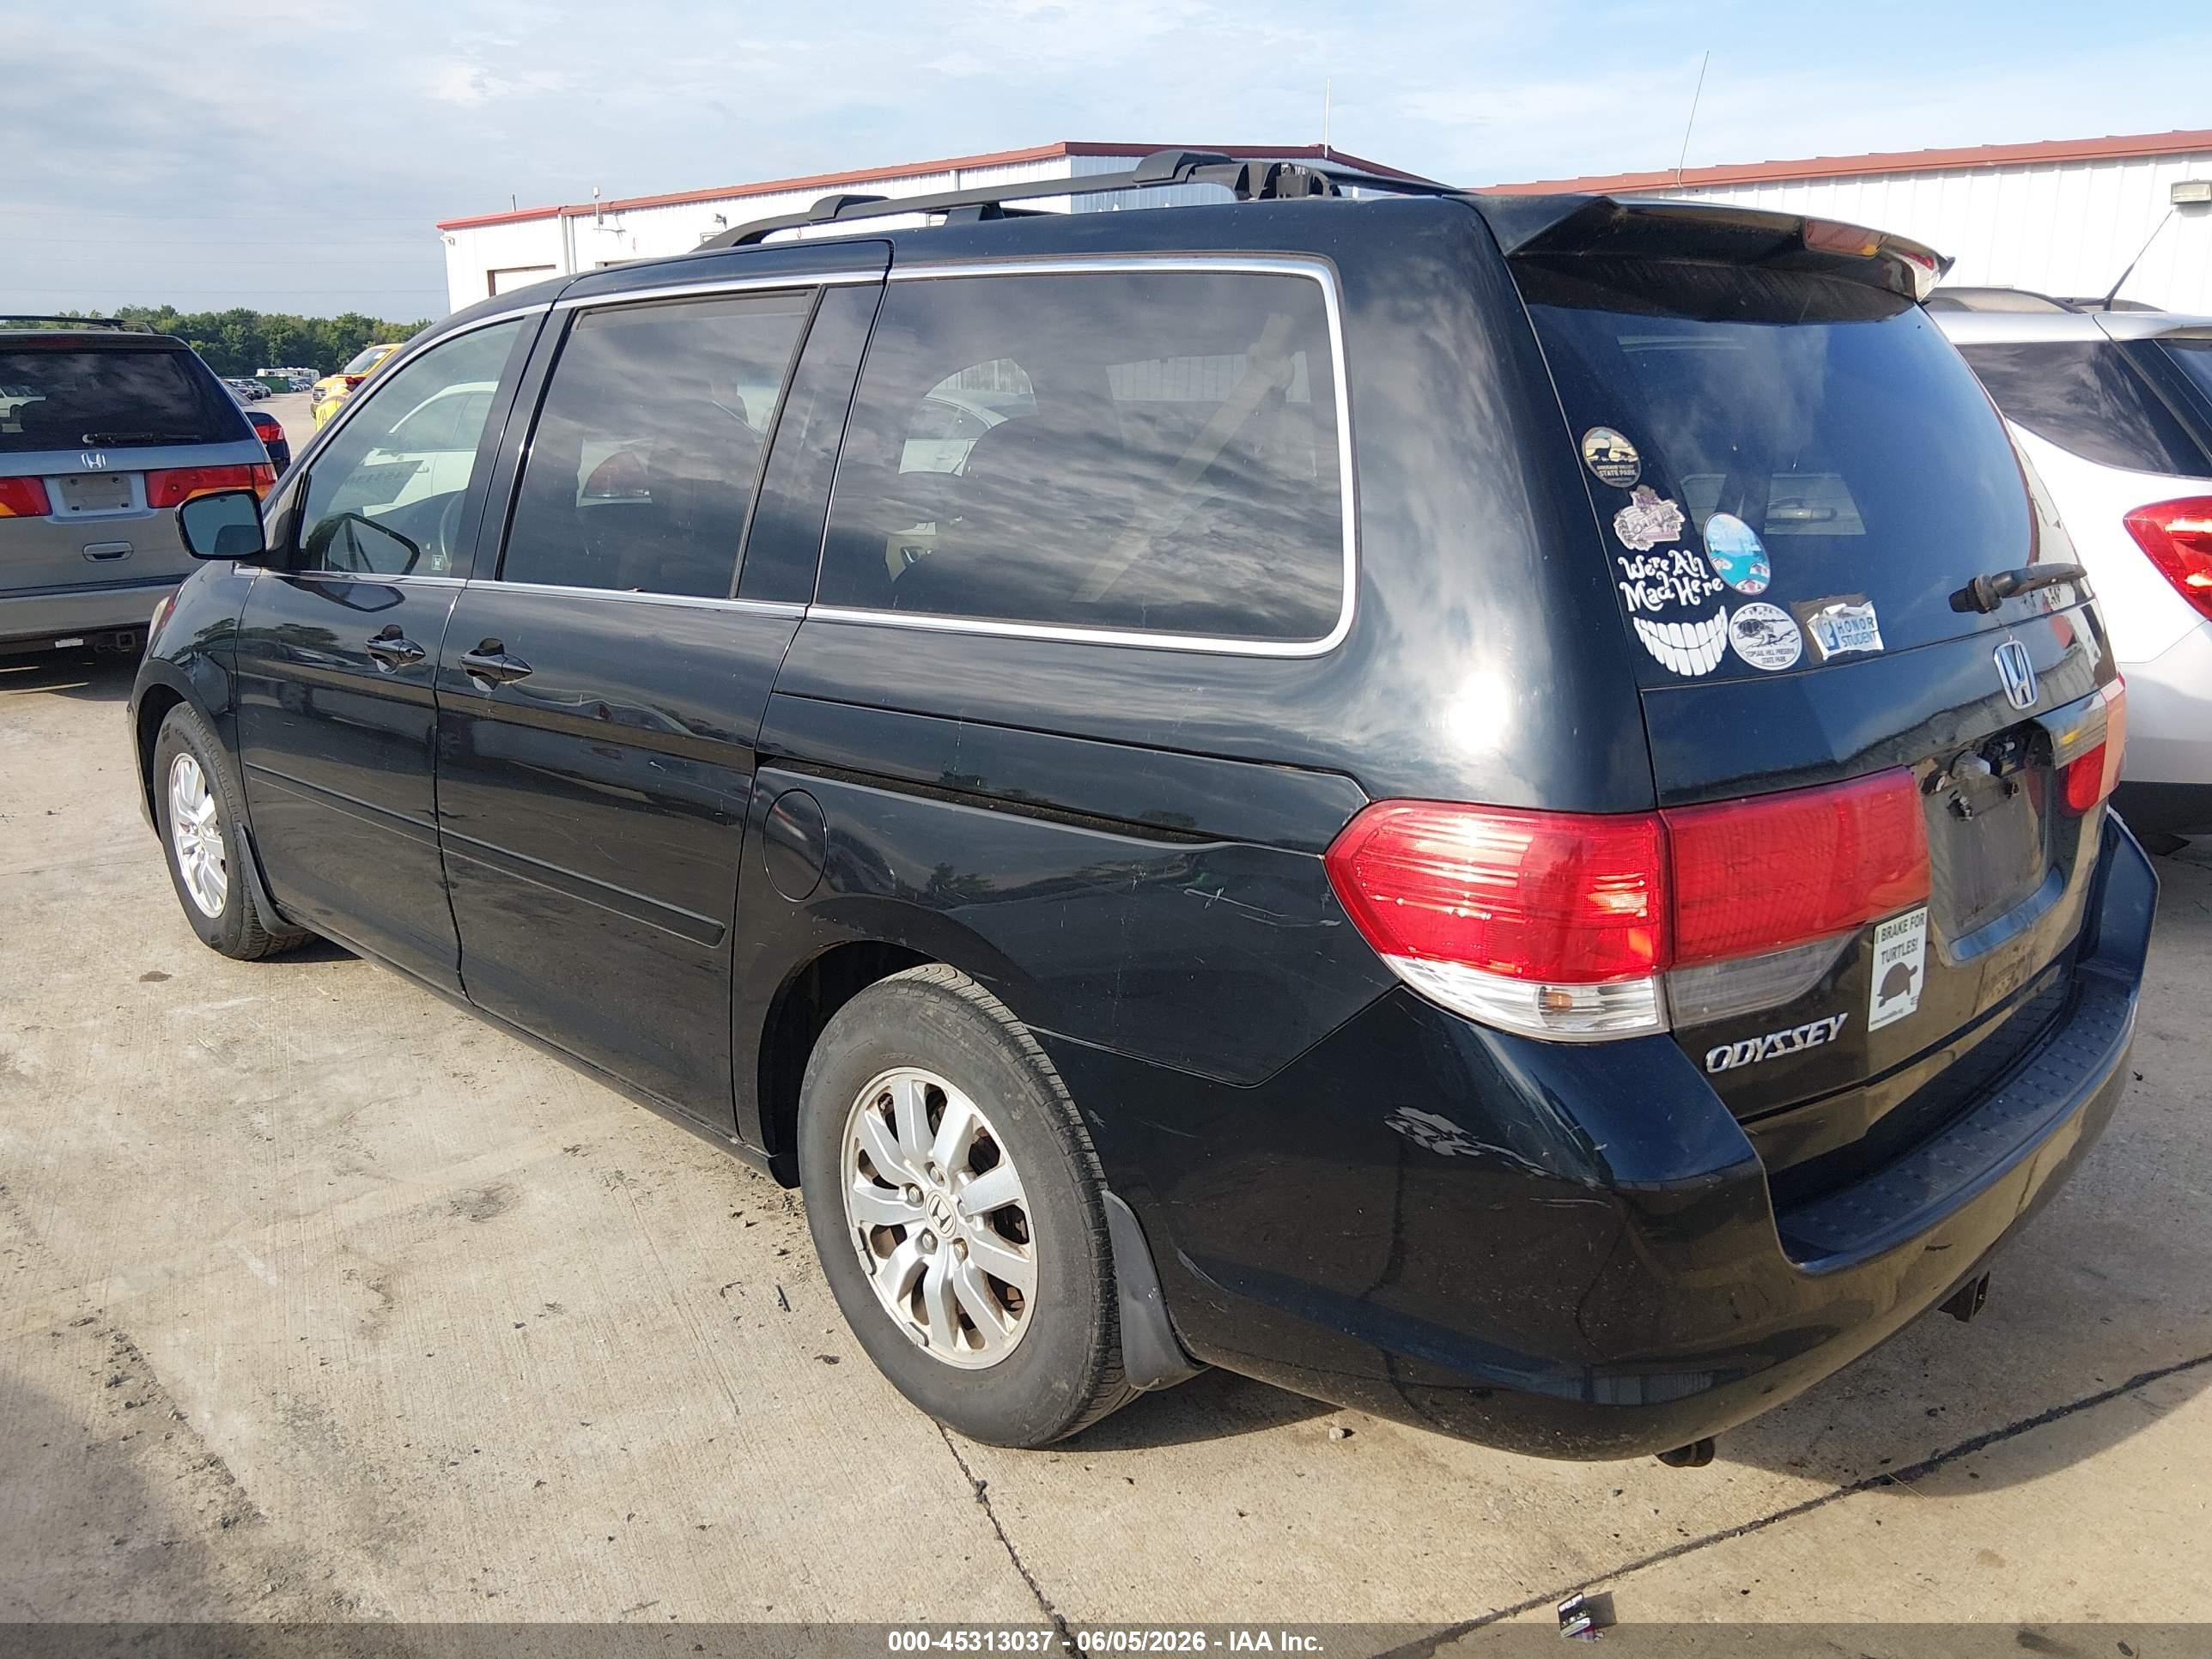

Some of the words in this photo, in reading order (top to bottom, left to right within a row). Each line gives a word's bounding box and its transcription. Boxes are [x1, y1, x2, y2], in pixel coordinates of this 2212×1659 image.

[1619, 570, 1675, 612] Mad
[1669, 576, 1723, 605] Here
[1836, 617, 1875, 634] HONOR
[1881, 919, 1907, 942] BRAKE
[1910, 912, 1925, 928] FOR
[1881, 937, 1918, 965] TURTLES!
[1705, 1012, 1848, 1073] ODYSSEY
